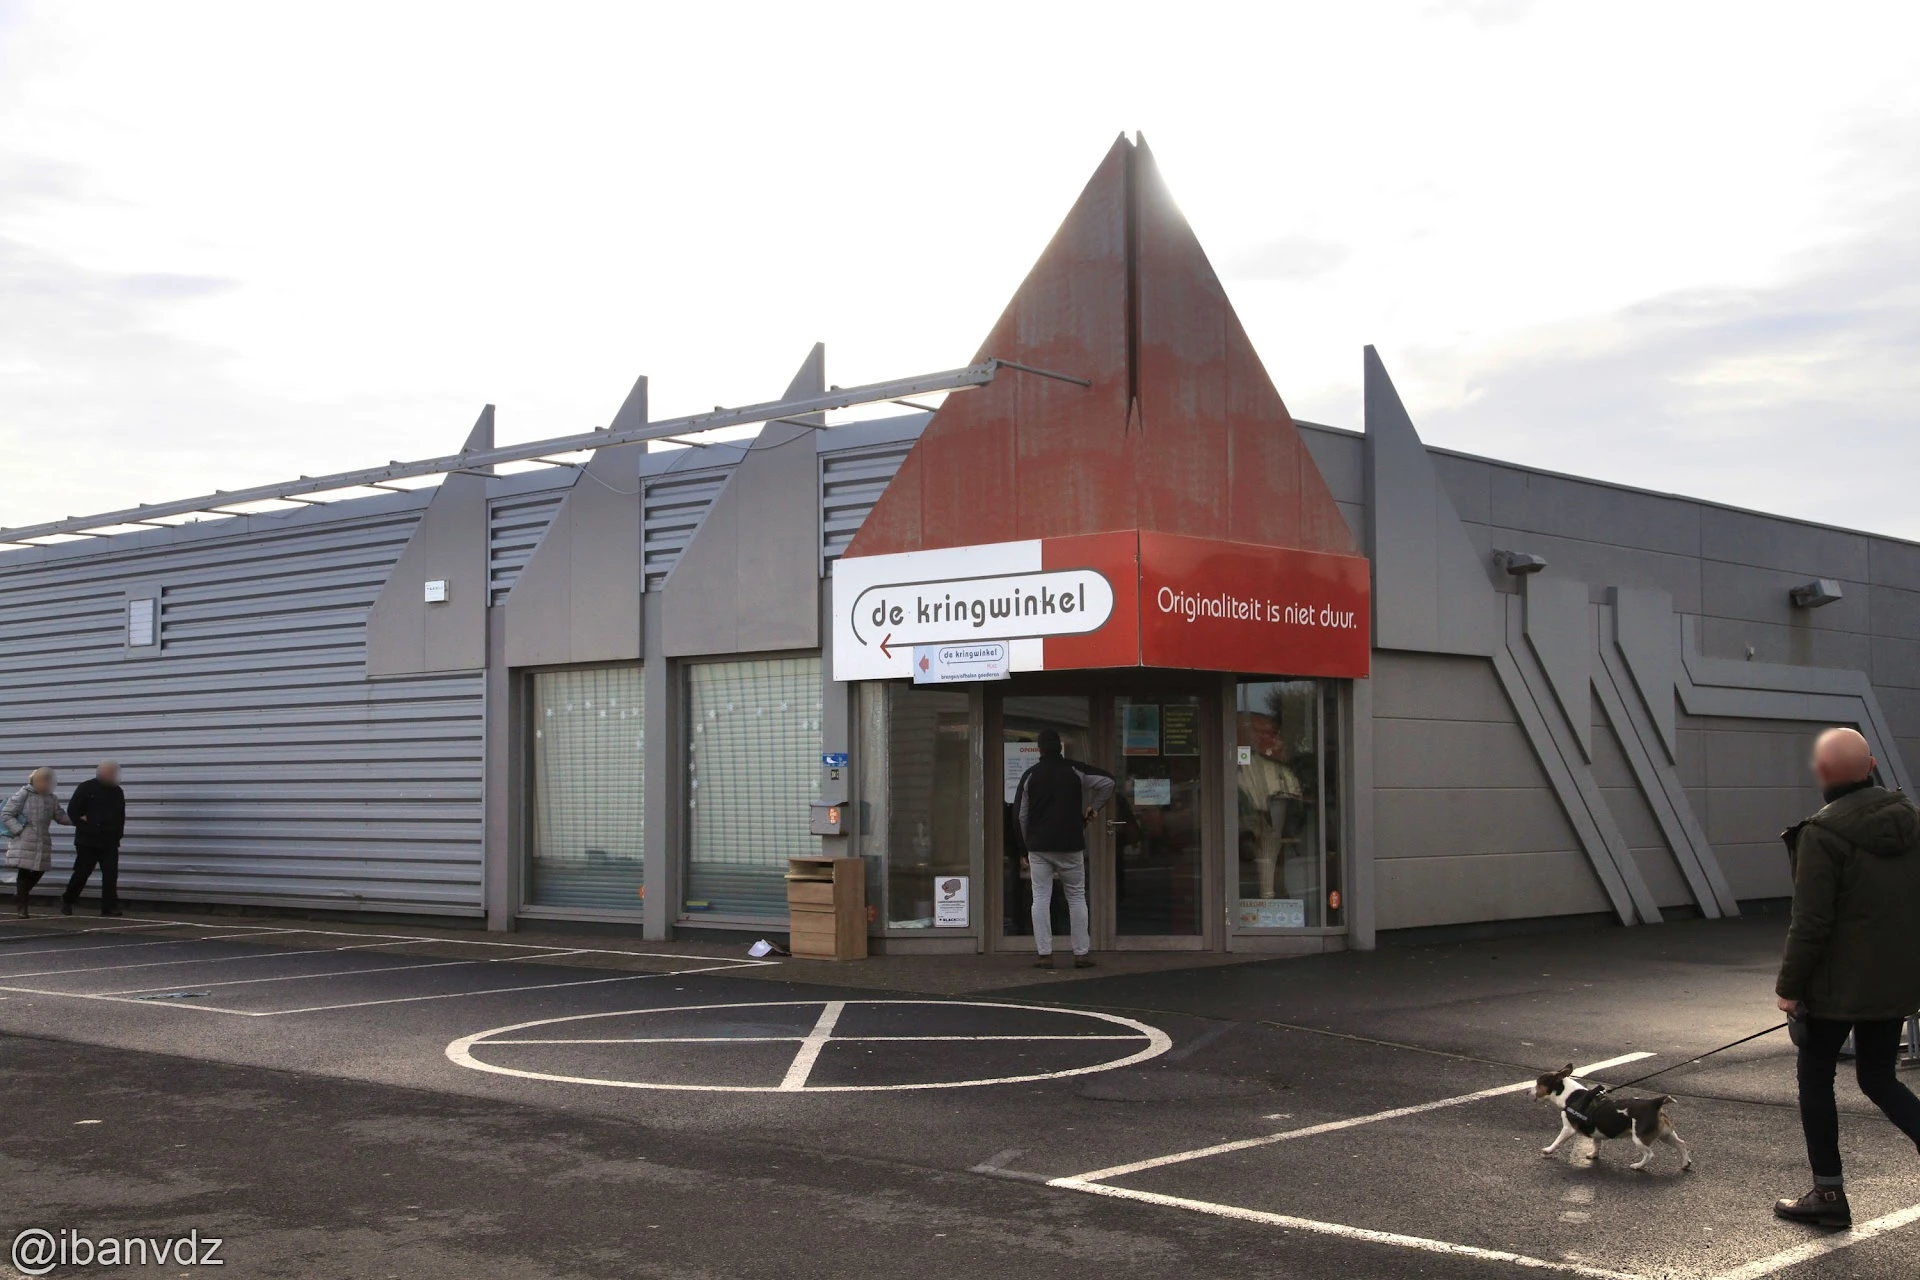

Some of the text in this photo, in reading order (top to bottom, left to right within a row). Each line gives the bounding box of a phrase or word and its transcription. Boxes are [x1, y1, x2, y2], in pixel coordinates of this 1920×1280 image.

[872, 583, 1085, 628] de kringwinkel
[1157, 586, 1357, 629] Originaliteit is niet duur.
[944, 648, 997, 659] de kringwinkel
